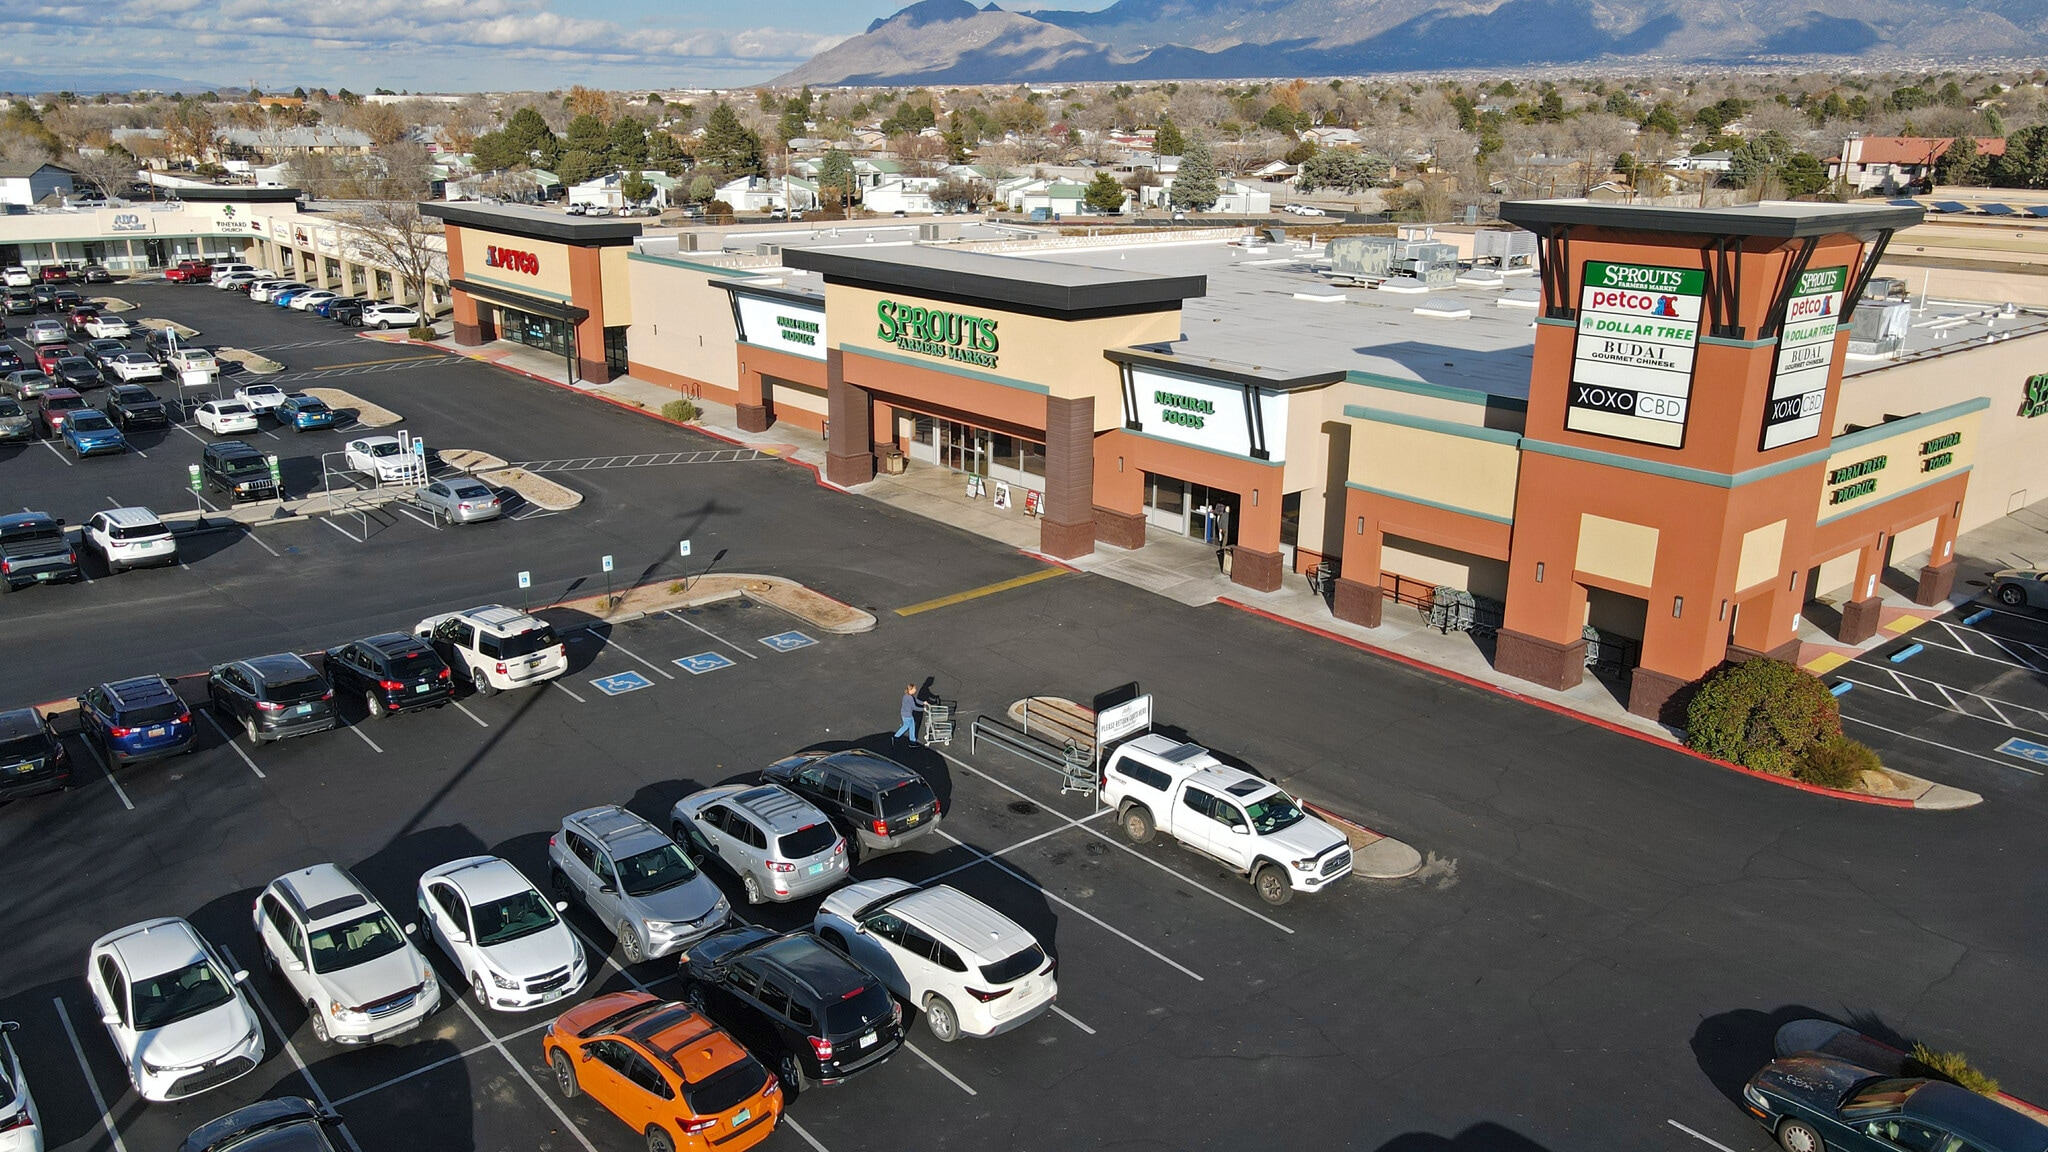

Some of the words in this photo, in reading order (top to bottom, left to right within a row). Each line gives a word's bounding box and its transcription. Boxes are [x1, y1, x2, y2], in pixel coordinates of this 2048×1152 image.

[498, 247, 539, 276] PETCO
[1602, 265, 1682, 286] SPROUTS
[1799, 270, 1837, 294] SPROUTS
[1618, 281, 1648, 290] FARMERS
[1649, 284, 1677, 293] MARKET
[1592, 291, 1653, 310] petco
[1791, 298, 1821, 320] petco
[776, 315, 797, 329] FARM
[797, 319, 819, 334] FRESH
[877, 299, 999, 353] SPROUTS
[1596, 320, 1653, 336] DOLLAR
[1657, 326, 1694, 340] TREE
[1790, 327, 1818, 341] DOLLAR
[1819, 324, 1835, 336] TREE
[782, 329, 815, 346] PRODUCE
[896, 336, 945, 358] FARMERS
[947, 346, 998, 369] MARKET
[1592, 352, 1633, 363] GOURMET
[1636, 357, 1675, 368] CHINESE
[1604, 340, 1665, 360] BUDAI
[1791, 346, 1821, 362] BUDAI
[1154, 390, 1215, 415] NATURAL
[1577, 386, 1634, 410] XOXO
[1639, 396, 1681, 417] CBD
[1772, 398, 1801, 420] XOXO
[1802, 394, 1822, 412] CBD
[1162, 409, 1204, 429] FOODS
[1924, 432, 1961, 454] NATURA
[1833, 461, 1861, 484] FARM
[1861, 455, 1888, 475] FRESH
[1926, 452, 1953, 471] FOOD
[1101, 721, 1115, 732] PLEASE
